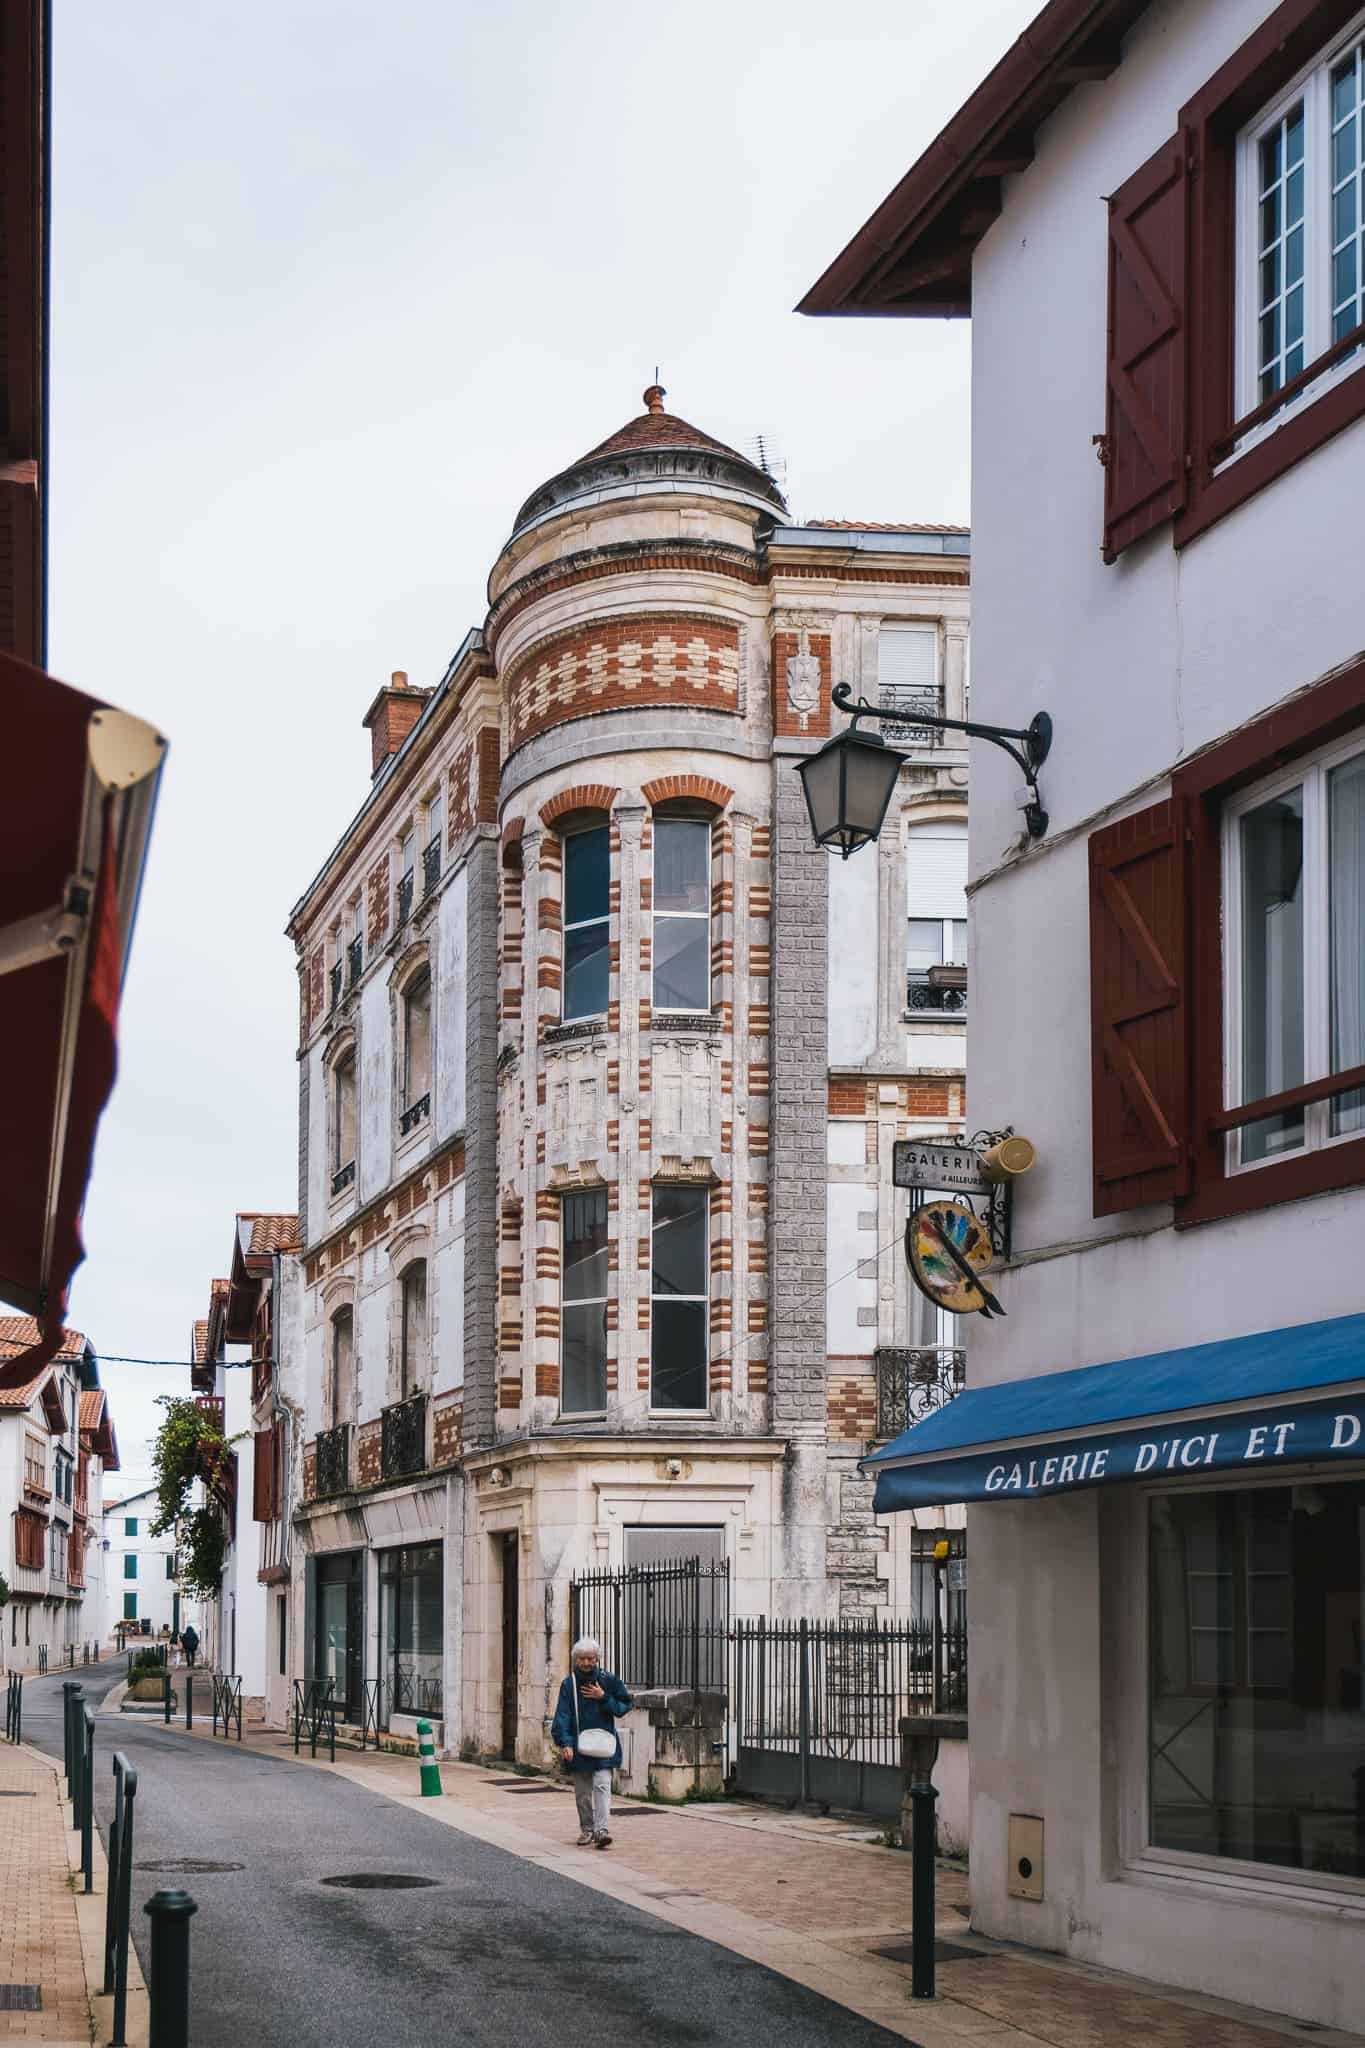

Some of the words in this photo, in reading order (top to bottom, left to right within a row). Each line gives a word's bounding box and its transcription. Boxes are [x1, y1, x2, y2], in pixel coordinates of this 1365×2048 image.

[984, 1449, 1109, 1491] GALERIE
[1134, 1433, 1219, 1472] D'ICI
[1243, 1422, 1295, 1459] ET
